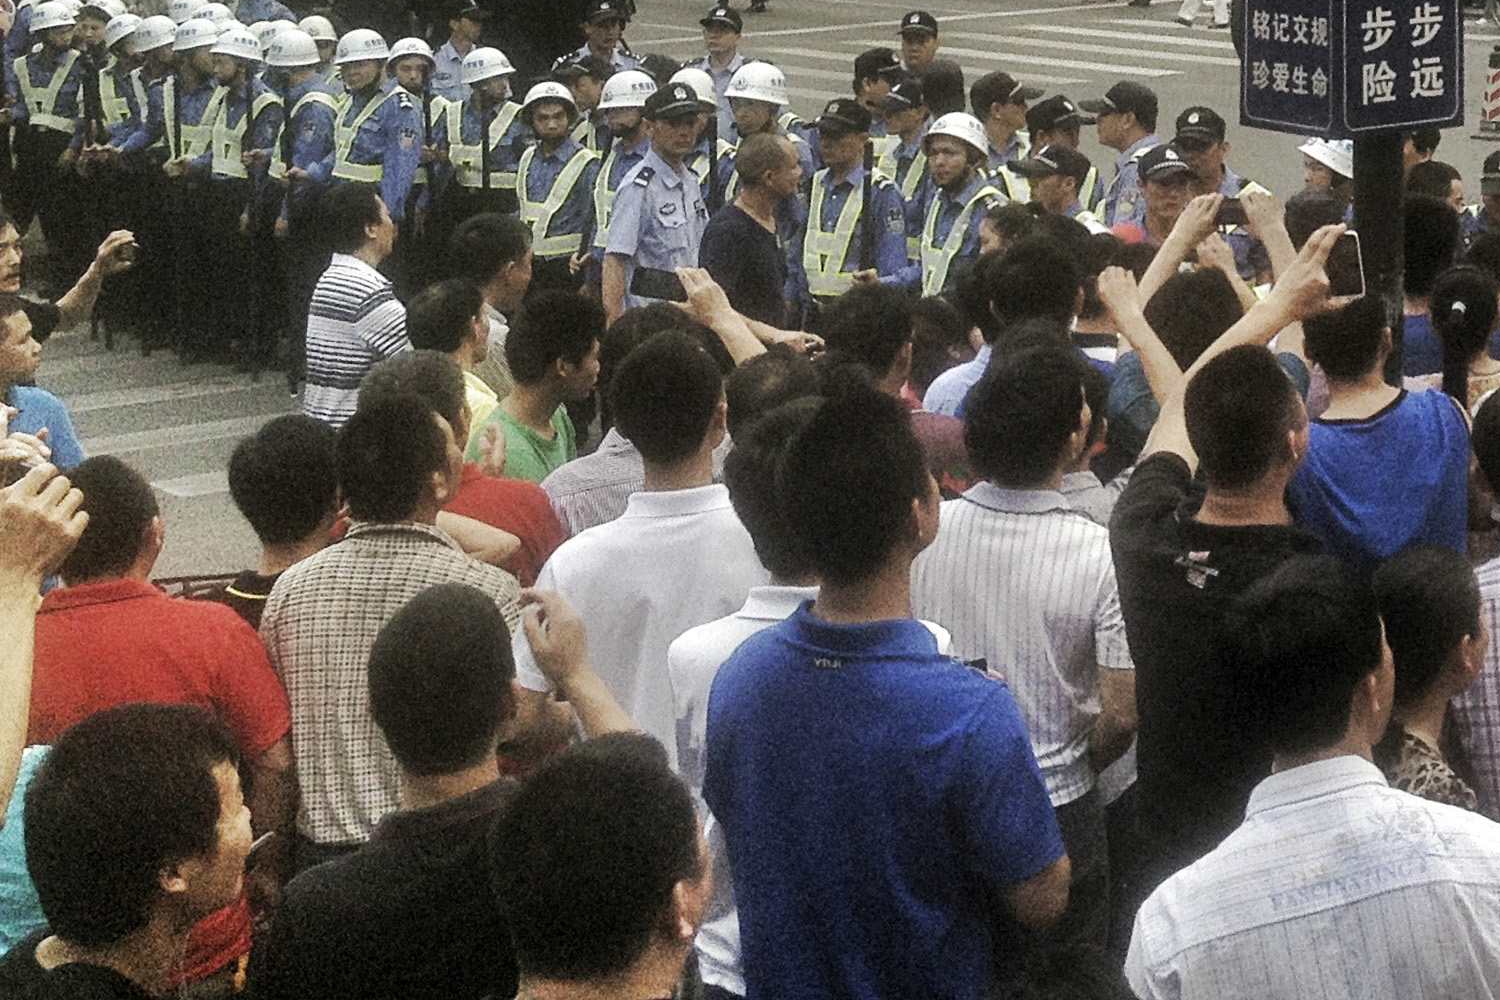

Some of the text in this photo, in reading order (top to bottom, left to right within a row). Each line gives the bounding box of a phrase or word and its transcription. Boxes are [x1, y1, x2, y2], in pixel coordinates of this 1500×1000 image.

[1252, 9, 1328, 47] 铭记交规
[1252, 59, 1329, 98] 珍爱生命
